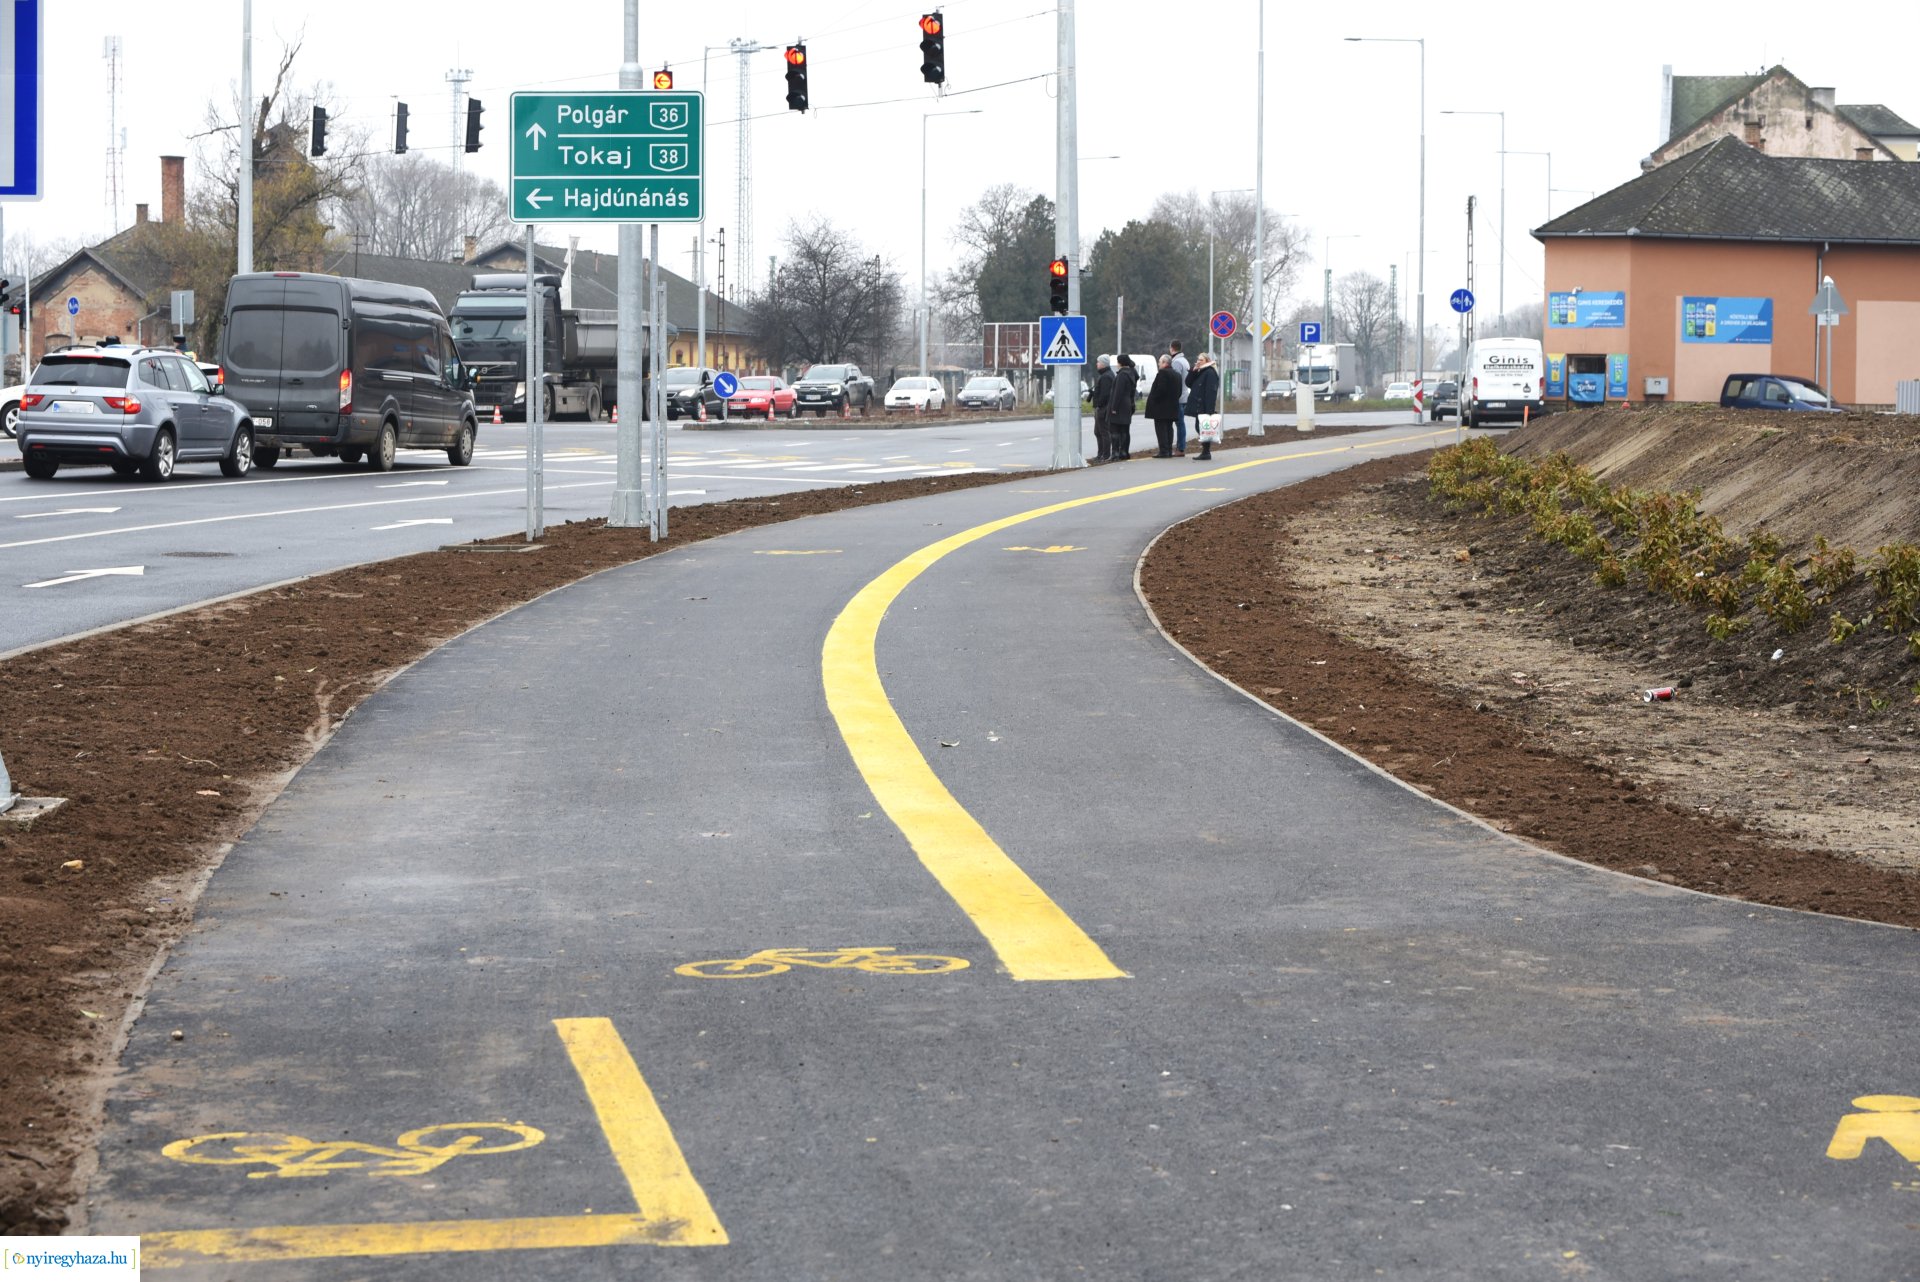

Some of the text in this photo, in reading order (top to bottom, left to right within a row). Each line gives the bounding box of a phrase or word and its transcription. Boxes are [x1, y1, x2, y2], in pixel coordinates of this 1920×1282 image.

[558, 104, 629, 128] Polgár
[659, 108, 679, 123] 36
[558, 146, 631, 169] Tokaj
[659, 149, 679, 164] 38
[564, 188, 689, 211] Hajdúnánás
[1305, 325, 1316, 341] P
[1489, 355, 1529, 364] Ginis
